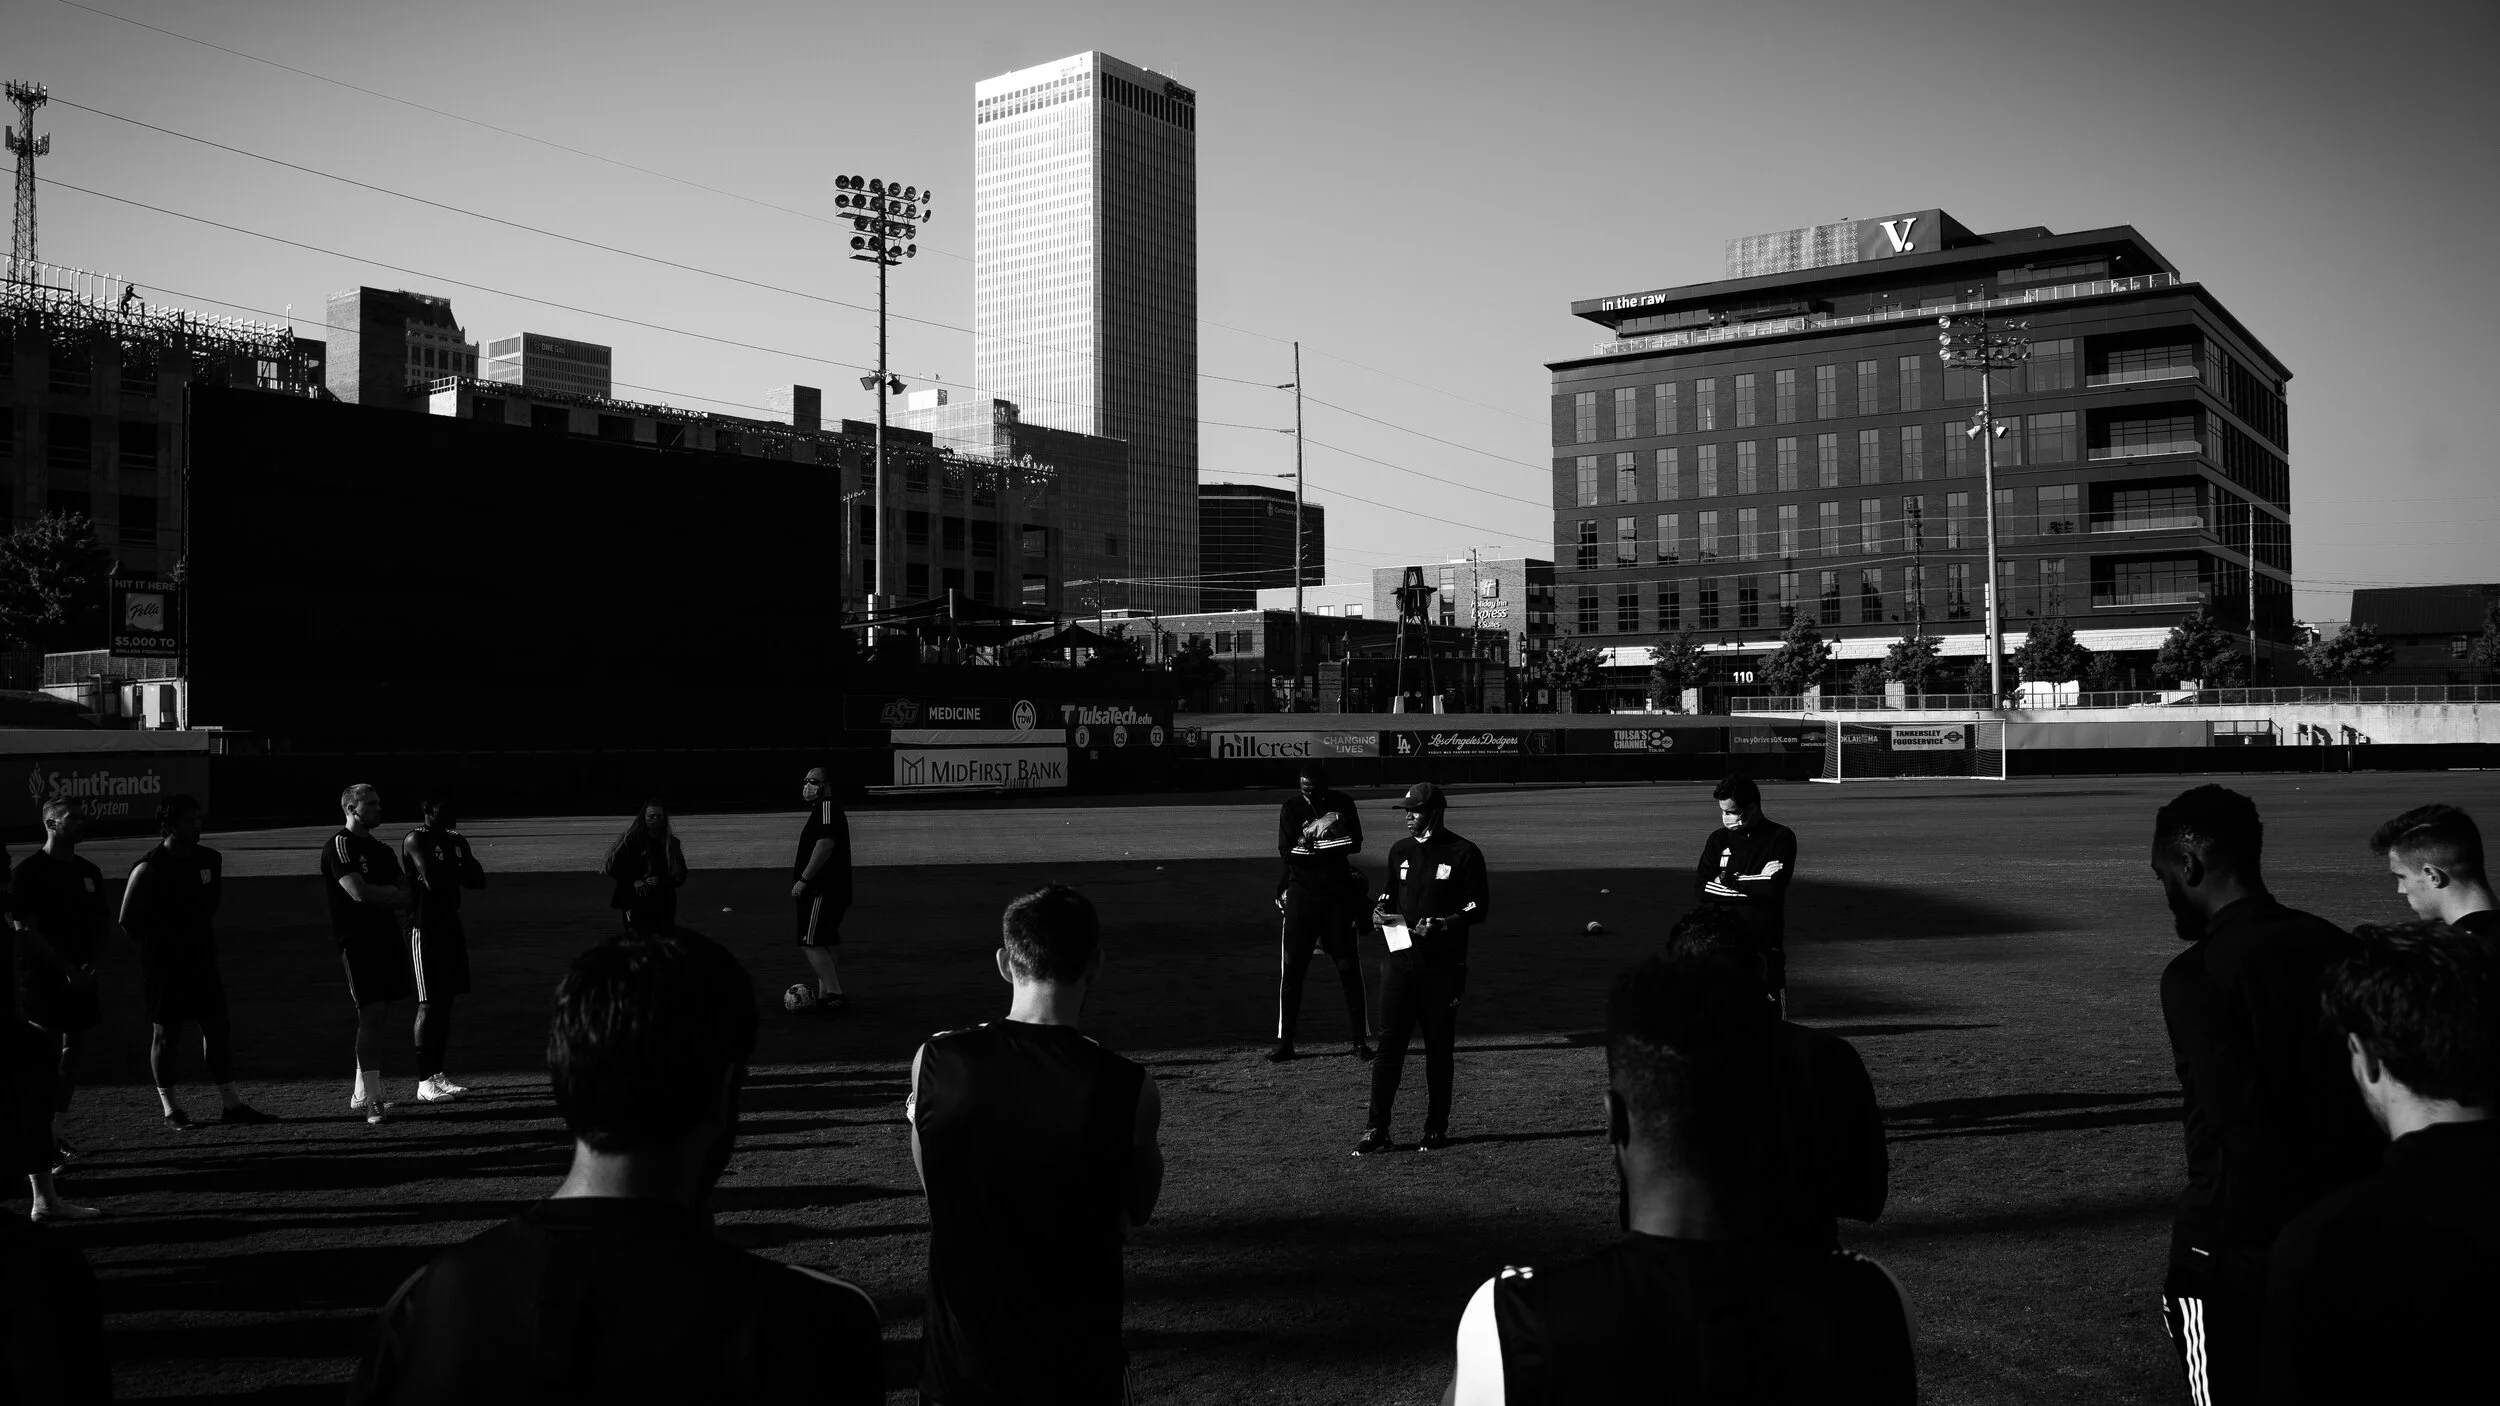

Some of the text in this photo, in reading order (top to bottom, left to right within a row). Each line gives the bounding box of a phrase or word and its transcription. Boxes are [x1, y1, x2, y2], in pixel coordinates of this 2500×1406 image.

[1602, 294, 1666, 311] in the raw
[115, 580, 176, 591] HIT IT HERE
[130, 603, 159, 619] Pella
[1471, 609, 1508, 620] Express
[115, 636, 176, 648] $5,000 TO
[1733, 671, 1753, 683] 110
[880, 698, 981, 728] OSU MEDICINE
[1078, 705, 1152, 725] TulsaTech.edu
[1017, 715, 1031, 724] TDW
[1323, 736, 1376, 745] CHANGING
[1614, 730, 1647, 739] TULSA'S
[1219, 735, 1311, 758] hillcrest
[1397, 734, 1411, 754] LA
[1428, 733, 1518, 750] Los Angeles Dodgers
[1614, 740, 1647, 749] CHANNEL
[1336, 745, 1363, 753] LIVES
[90, 800, 129, 819] System
